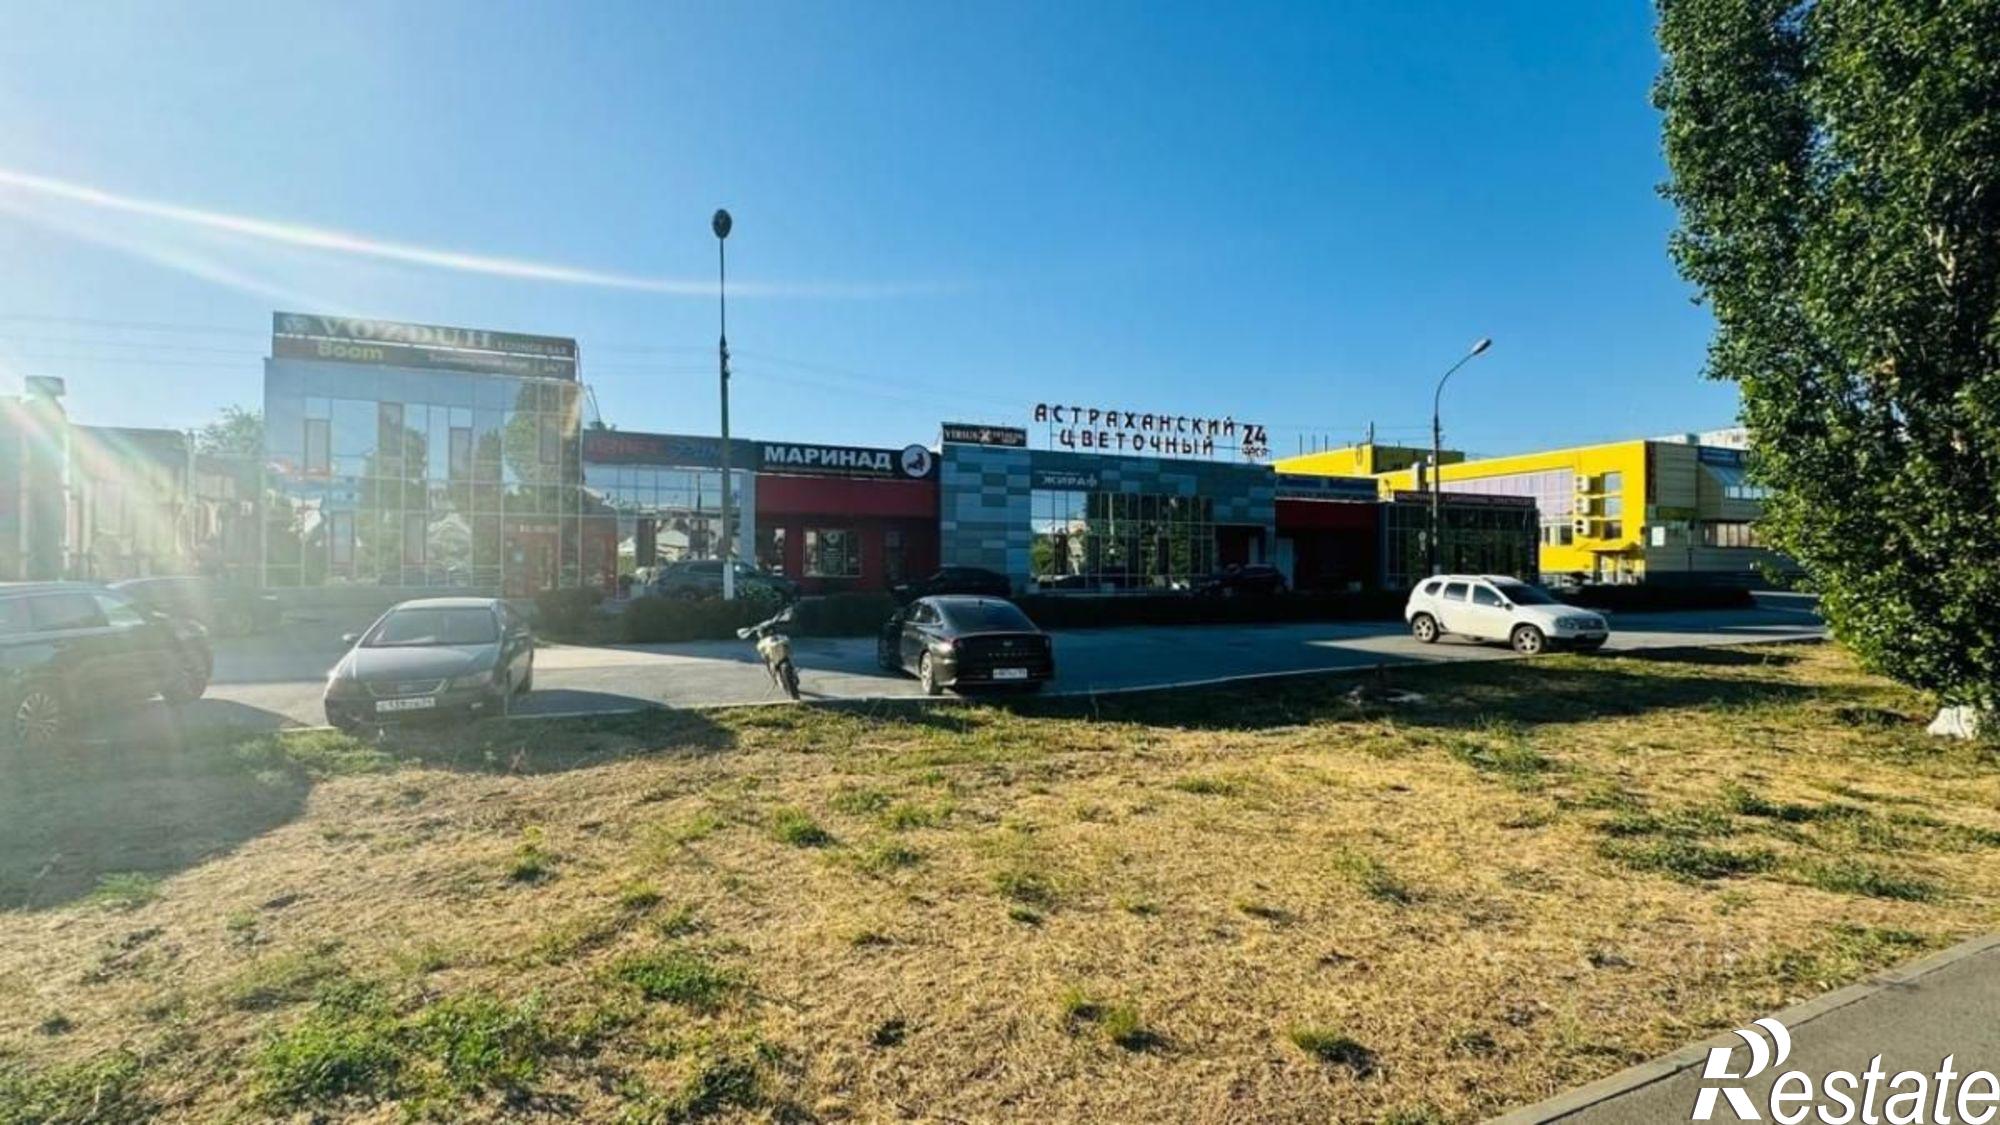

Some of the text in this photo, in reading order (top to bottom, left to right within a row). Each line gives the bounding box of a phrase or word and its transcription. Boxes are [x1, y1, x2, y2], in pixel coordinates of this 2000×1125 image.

[318, 340, 384, 360] Boom
[1034, 403, 1235, 436] АСТРАХАНСКИЙ
[1060, 429, 1214, 456] ЦВЕТОЧНЫЙ
[1243, 424, 1267, 446] 24
[763, 445, 893, 470] МАРИНАД
[1041, 473, 1098, 488] ЖИРАФ
